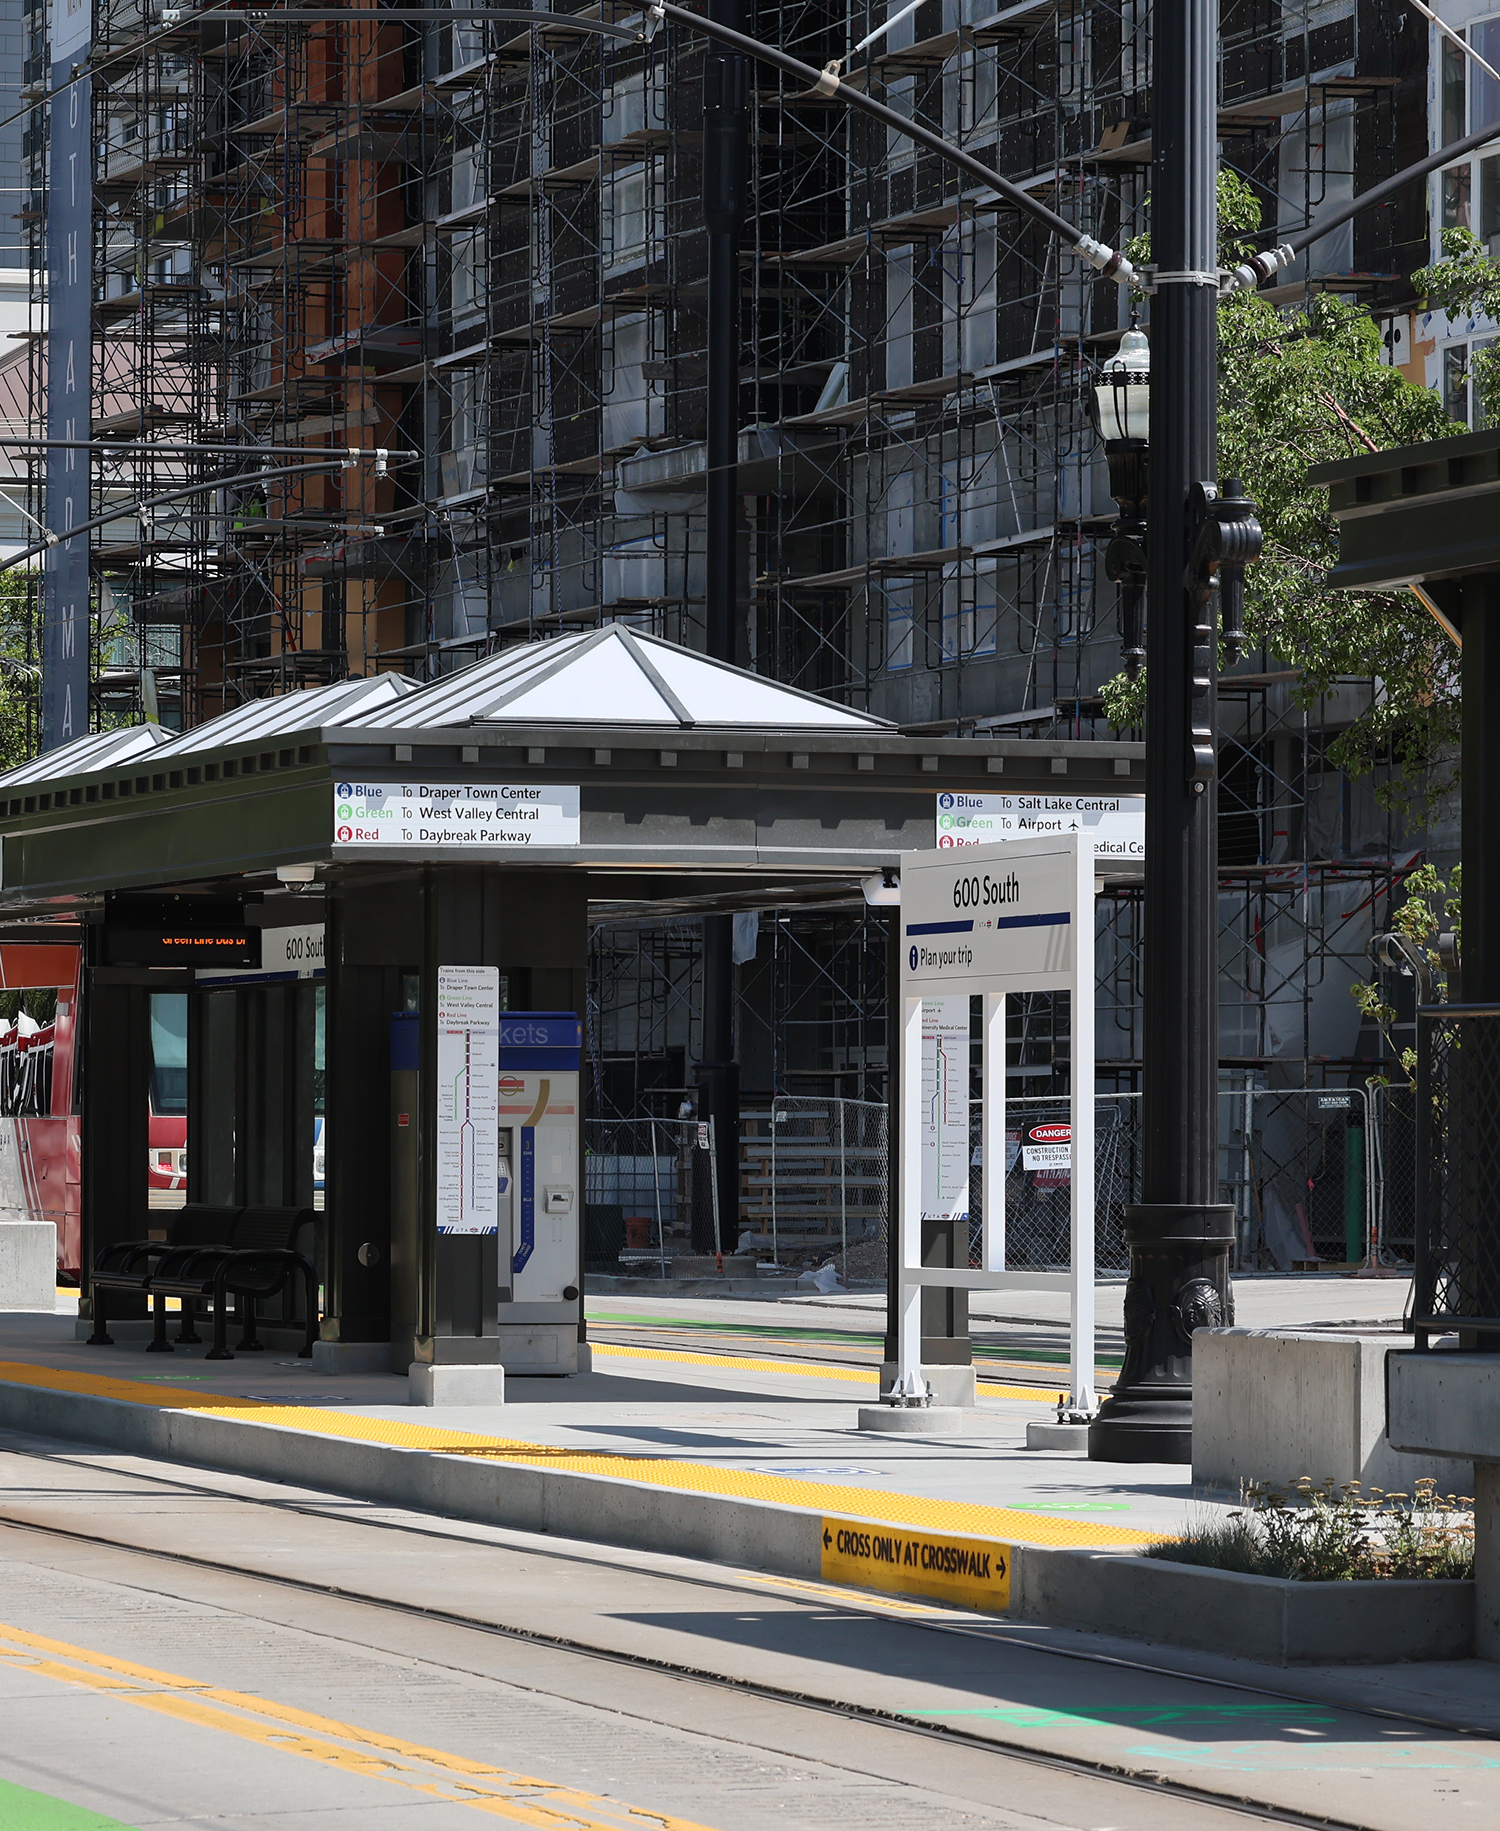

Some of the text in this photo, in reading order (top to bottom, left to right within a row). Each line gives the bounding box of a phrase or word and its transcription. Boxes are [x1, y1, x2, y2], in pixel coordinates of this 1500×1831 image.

[65, 340, 76, 551] AND
[355, 784, 542, 801] Blue To Draper Town Center
[957, 795, 1120, 812] Blue To Salt Lake Central
[355, 806, 540, 822] Green To West Valley Central
[957, 817, 1062, 832] Green To Airport
[355, 828, 532, 844] Red To Daybreak Parkway
[1093, 841, 1126, 854] edical
[953, 871, 1020, 909] 600 South
[285, 937, 303, 961] 600
[920, 944, 973, 969] Plan your trip
[500, 1022, 549, 1044] kets
[1036, 1129, 1071, 1138] DANGER
[1026, 1147, 1069, 1155] CONSTRUCTION
[837, 1529, 991, 1579] CROSS ONLY AT CROSSWALK
